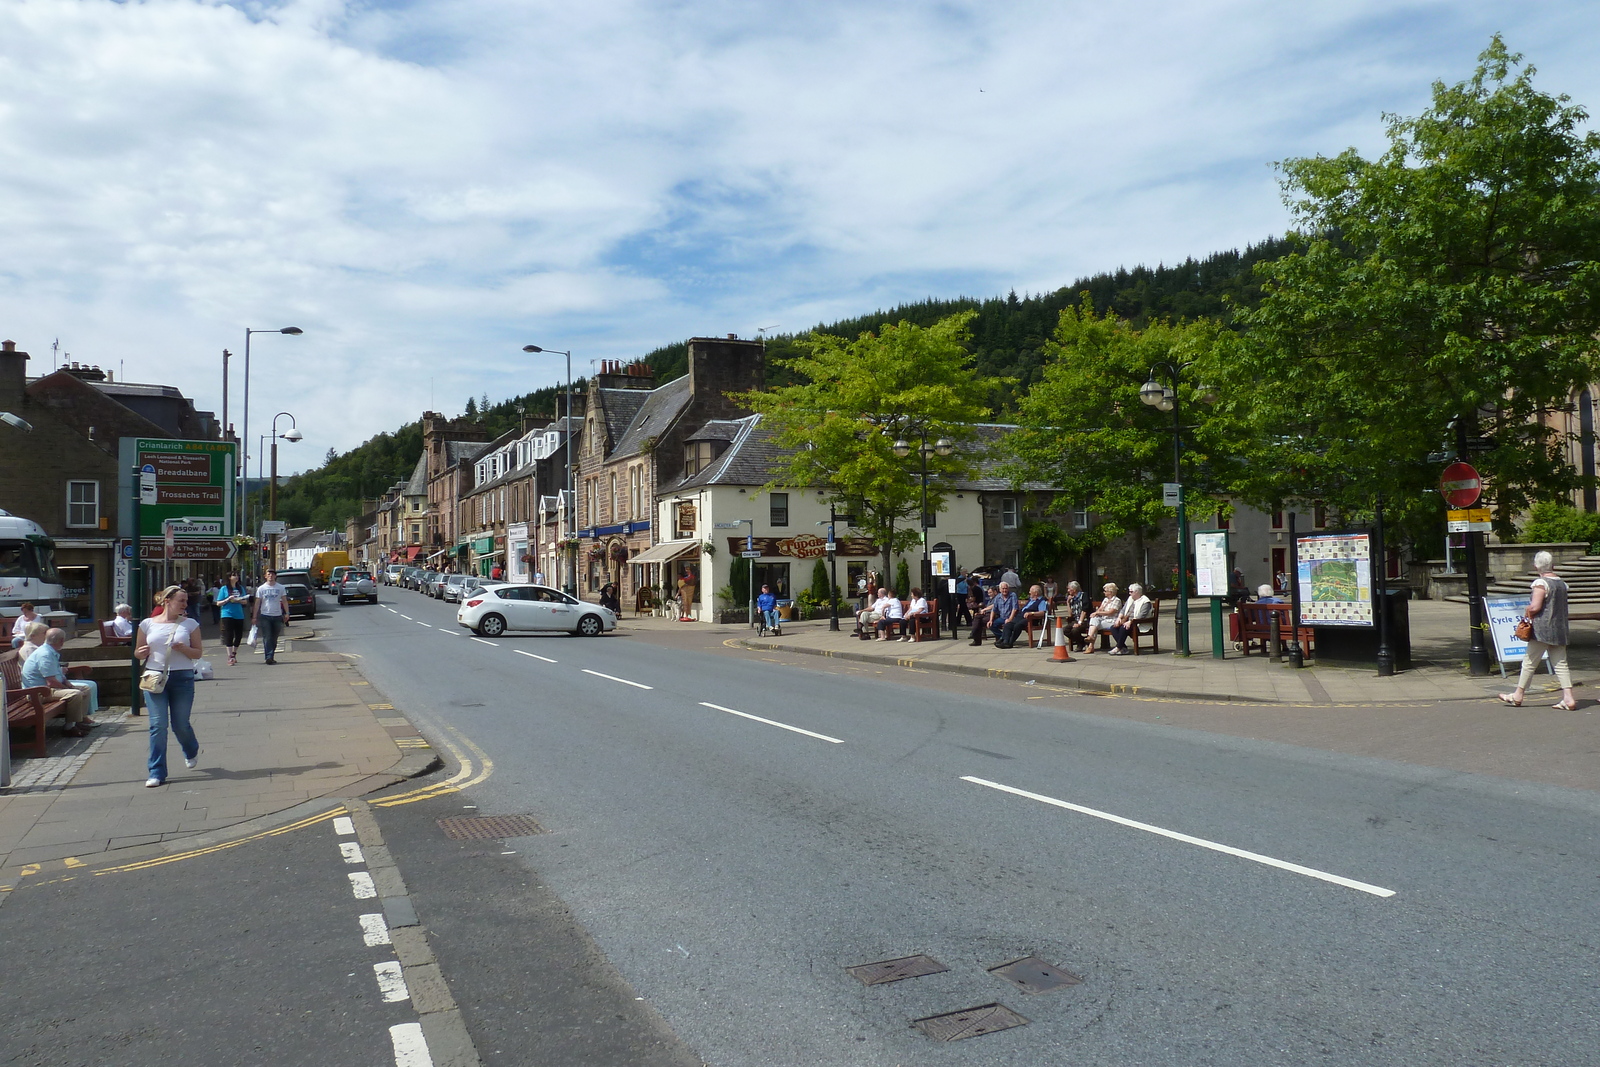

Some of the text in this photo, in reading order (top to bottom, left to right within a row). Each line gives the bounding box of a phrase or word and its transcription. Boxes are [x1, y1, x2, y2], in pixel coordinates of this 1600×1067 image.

[139, 441, 183, 450] Crianlarich
[158, 468, 208, 477] Breadalbane
[161, 490, 200, 499] Trossachs
[172, 525, 199, 533] lasgow
[1492, 616, 1512, 624] Cycle
